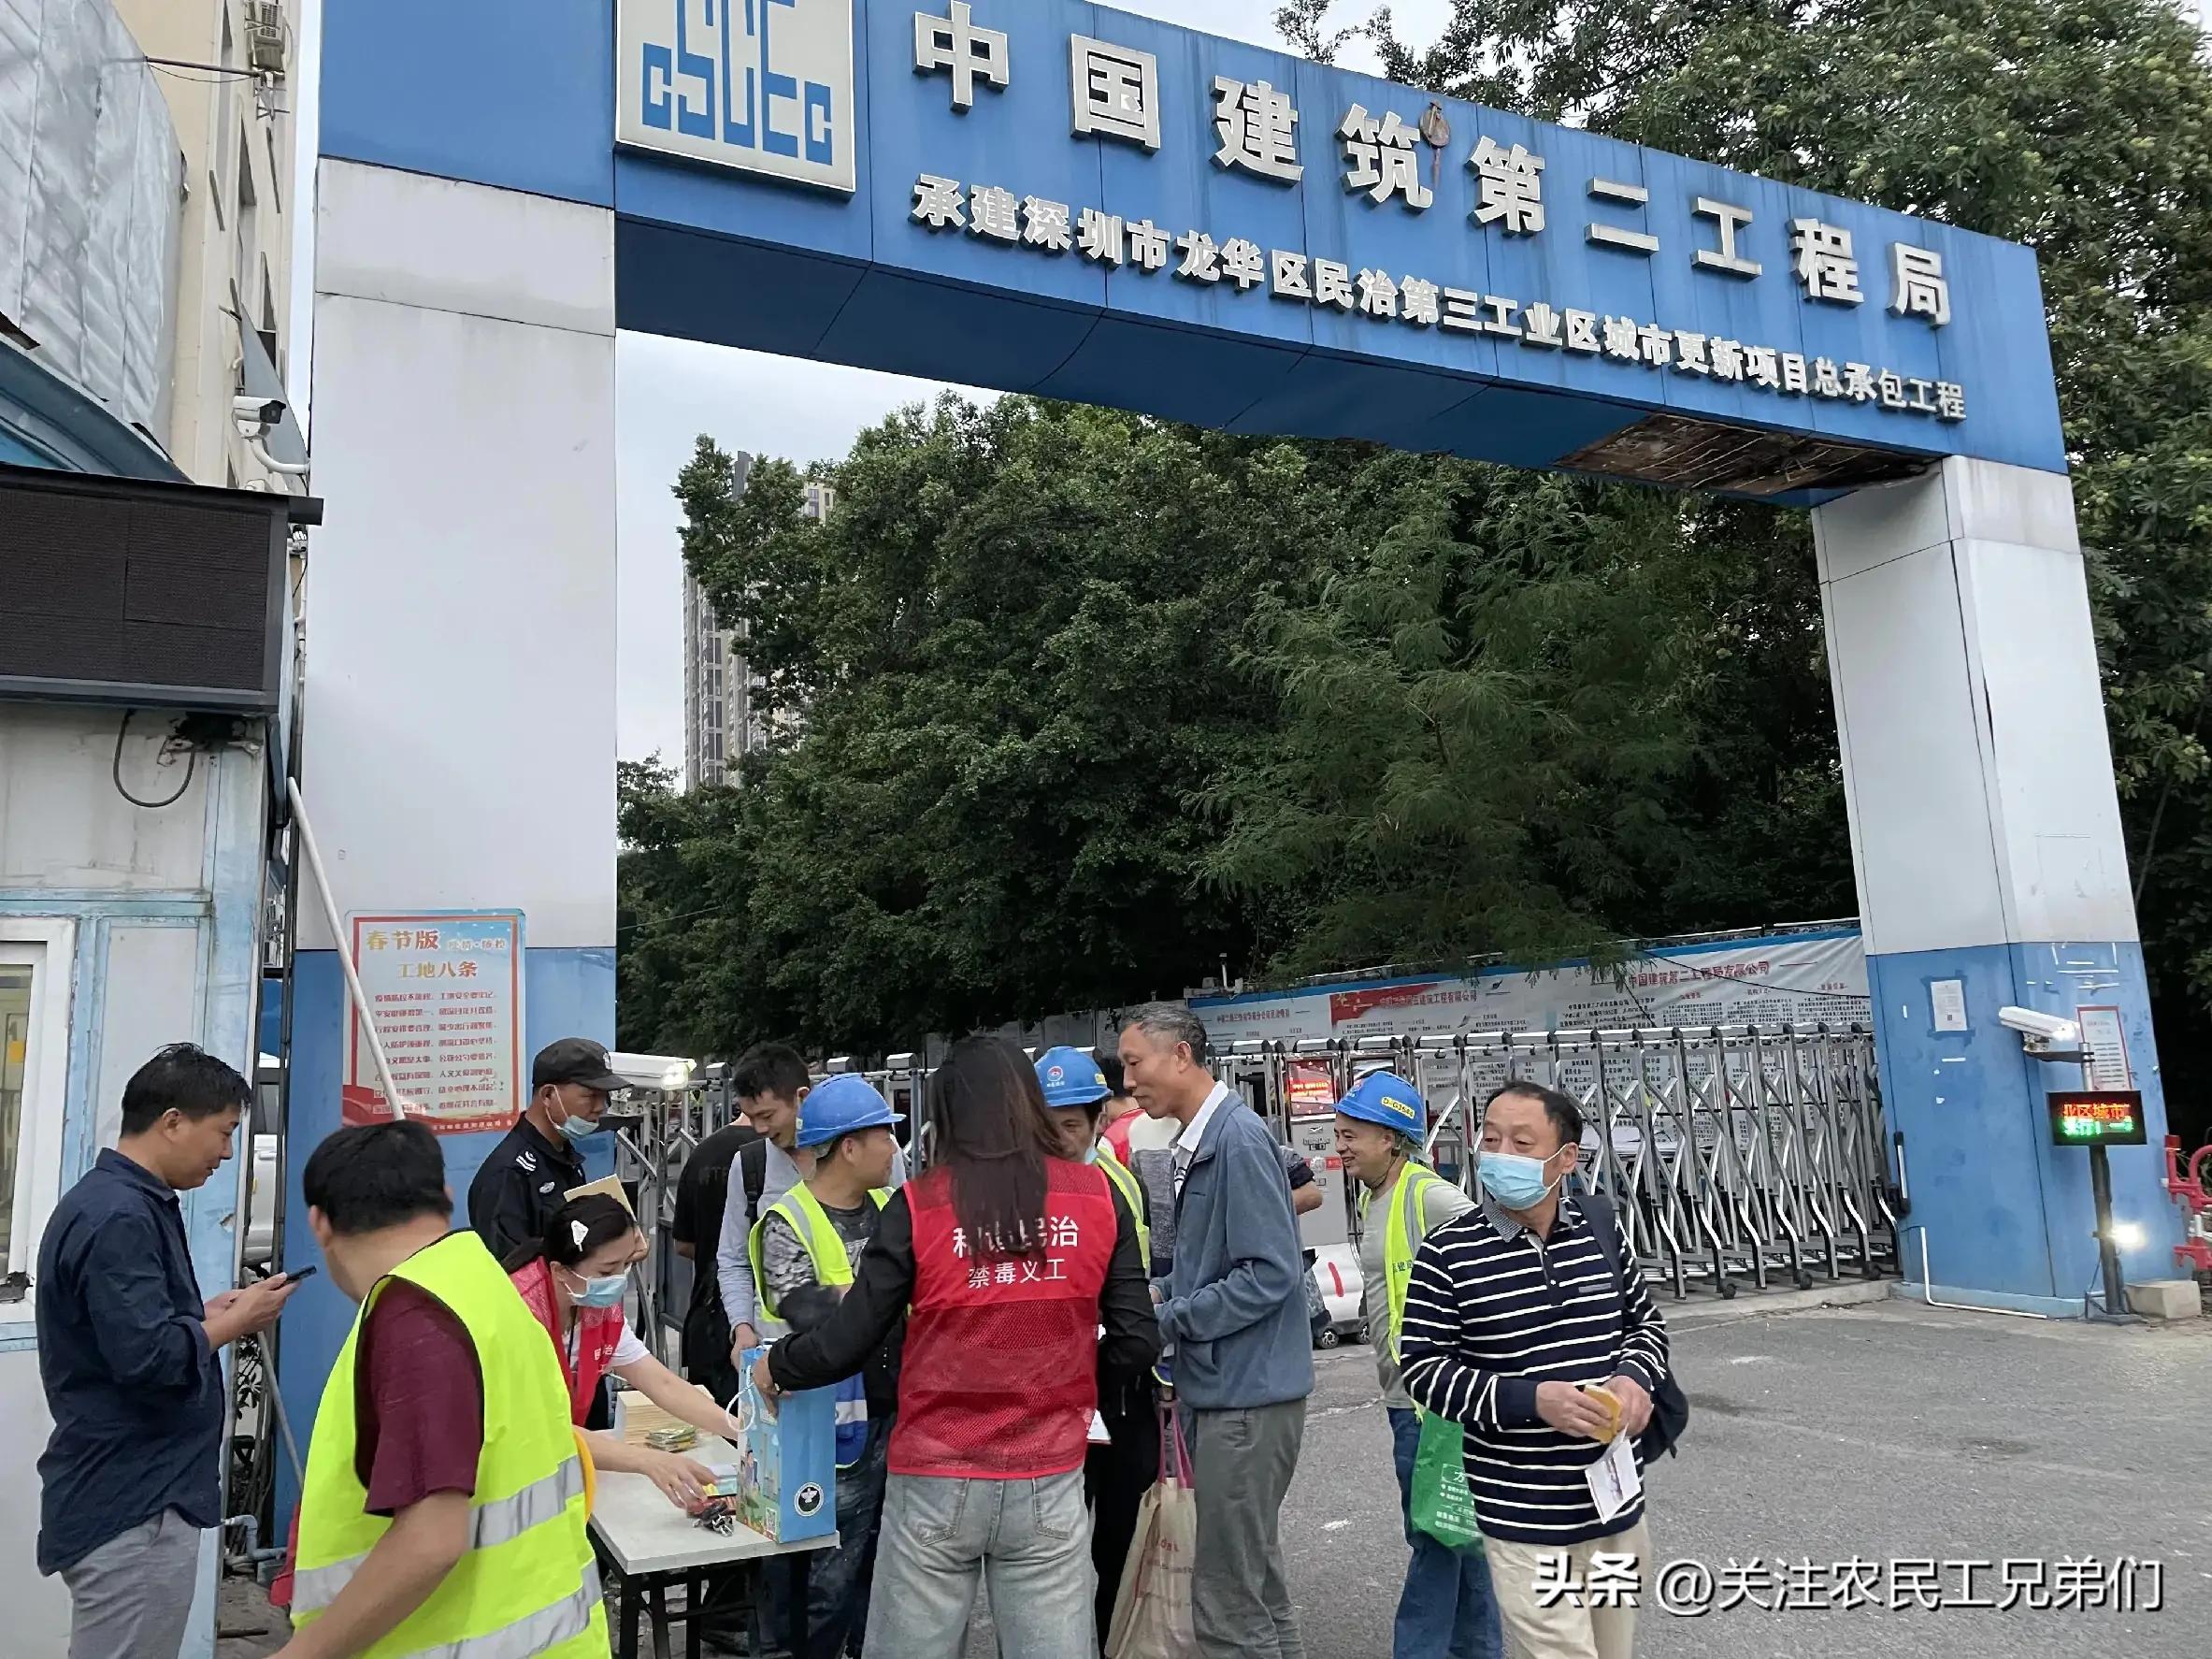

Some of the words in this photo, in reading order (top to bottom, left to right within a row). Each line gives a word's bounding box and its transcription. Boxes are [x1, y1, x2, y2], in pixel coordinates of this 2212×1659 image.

[912, 1, 1952, 328] 中国建筑第二工程局
[911, 173, 1967, 422] 承建深圳市龙华区民治第三工业区城市更新项目总承包工程
[366, 930, 440, 951] 春节版
[398, 960, 479, 979] 工地八条
[1629, 960, 1771, 988] 中国建筑第二工程局有限公司
[968, 1258, 1068, 1289] 禁毒义工
